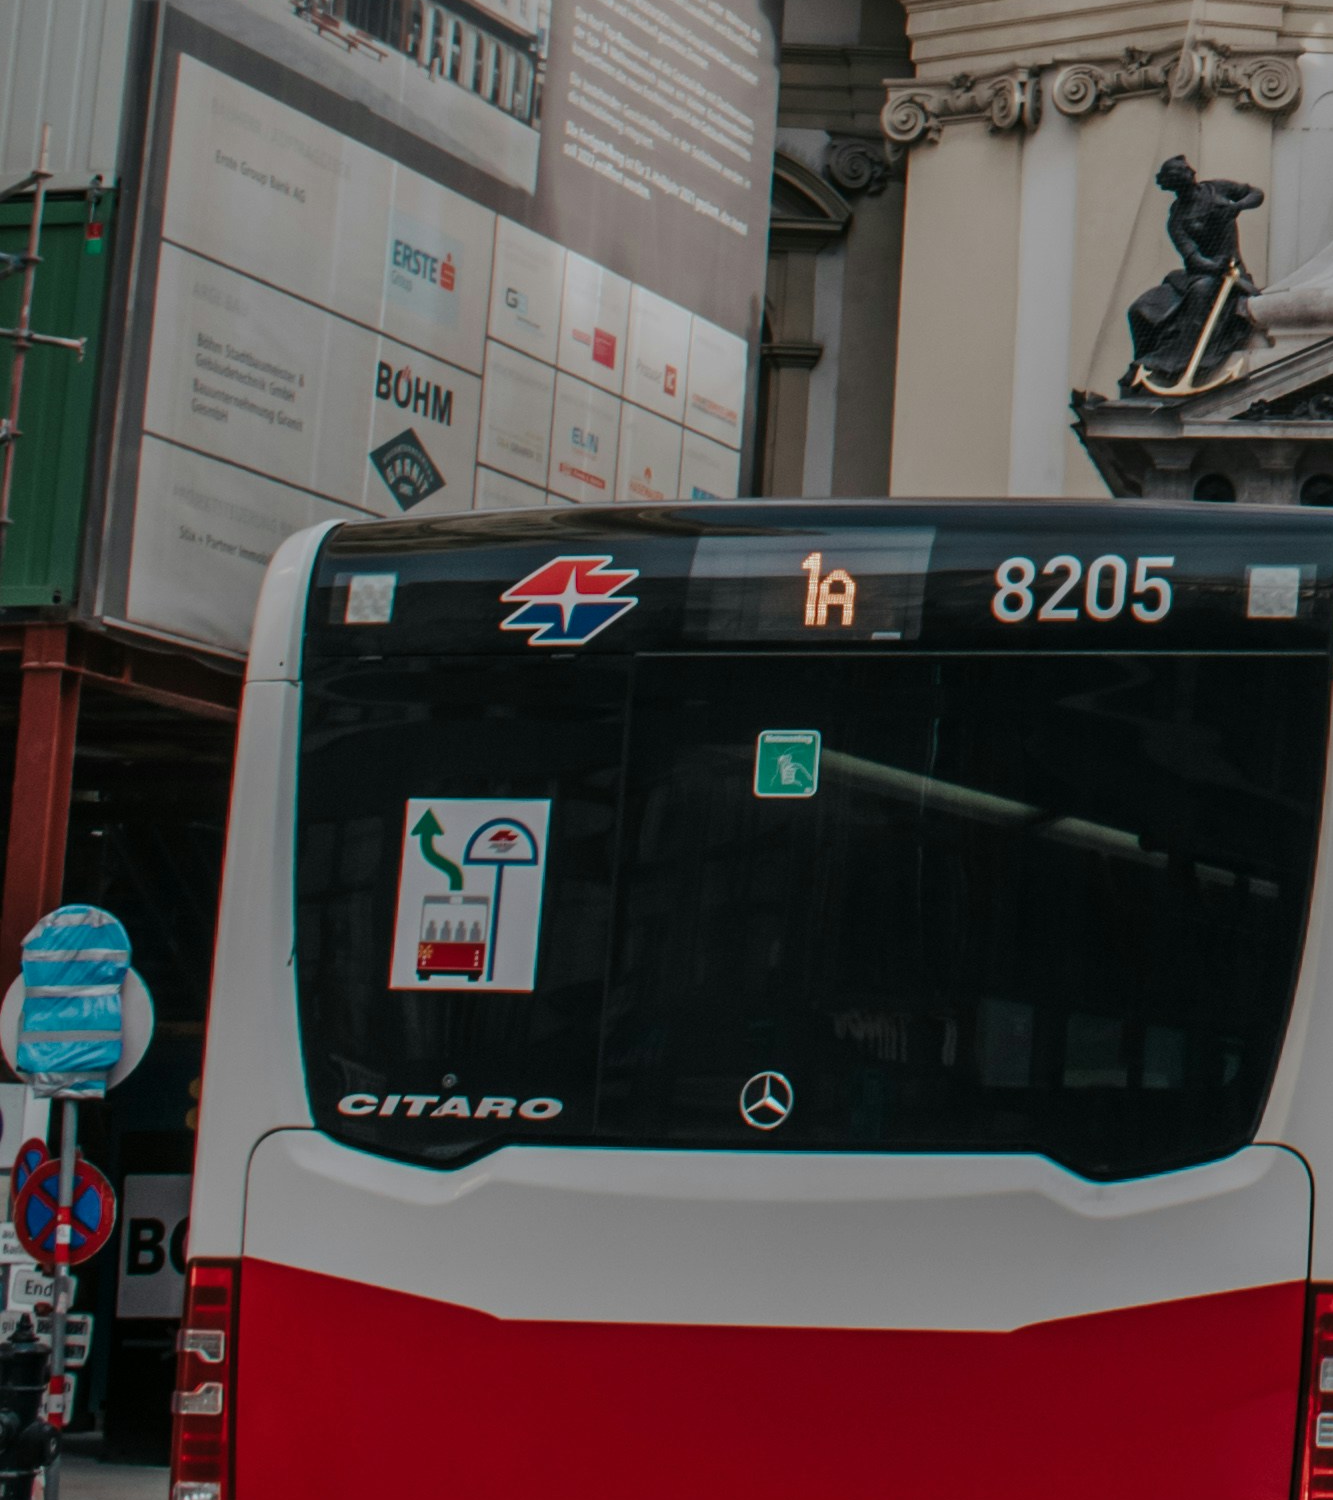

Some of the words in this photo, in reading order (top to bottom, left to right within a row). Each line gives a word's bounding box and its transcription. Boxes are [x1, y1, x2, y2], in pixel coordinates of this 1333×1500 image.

[392, 238, 438, 285] ERSTE
[801, 551, 857, 627] 1A
[992, 554, 1176, 624] 8205
[337, 1092, 564, 1121] CITARO
